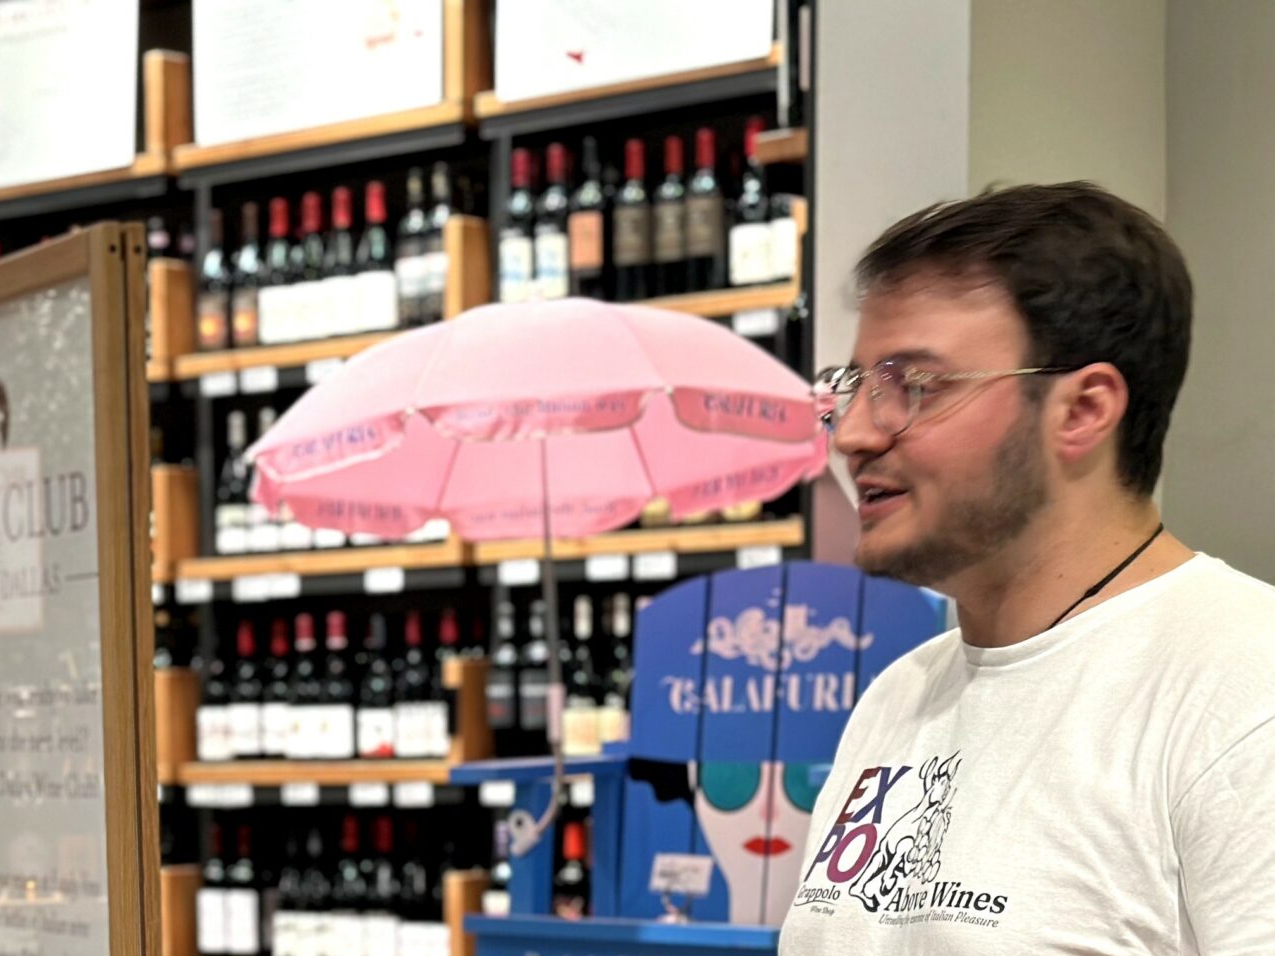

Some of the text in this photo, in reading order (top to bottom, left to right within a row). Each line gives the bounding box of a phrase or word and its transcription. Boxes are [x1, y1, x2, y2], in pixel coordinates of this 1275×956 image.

[2, 471, 90, 544] CLUB
[660, 671, 857, 715] CALAFURI
[836, 765, 913, 824] EX
[804, 823, 878, 884] PO
[884, 881, 1009, 915] Above Wines
[955, 911, 1000, 929] Pleasure
